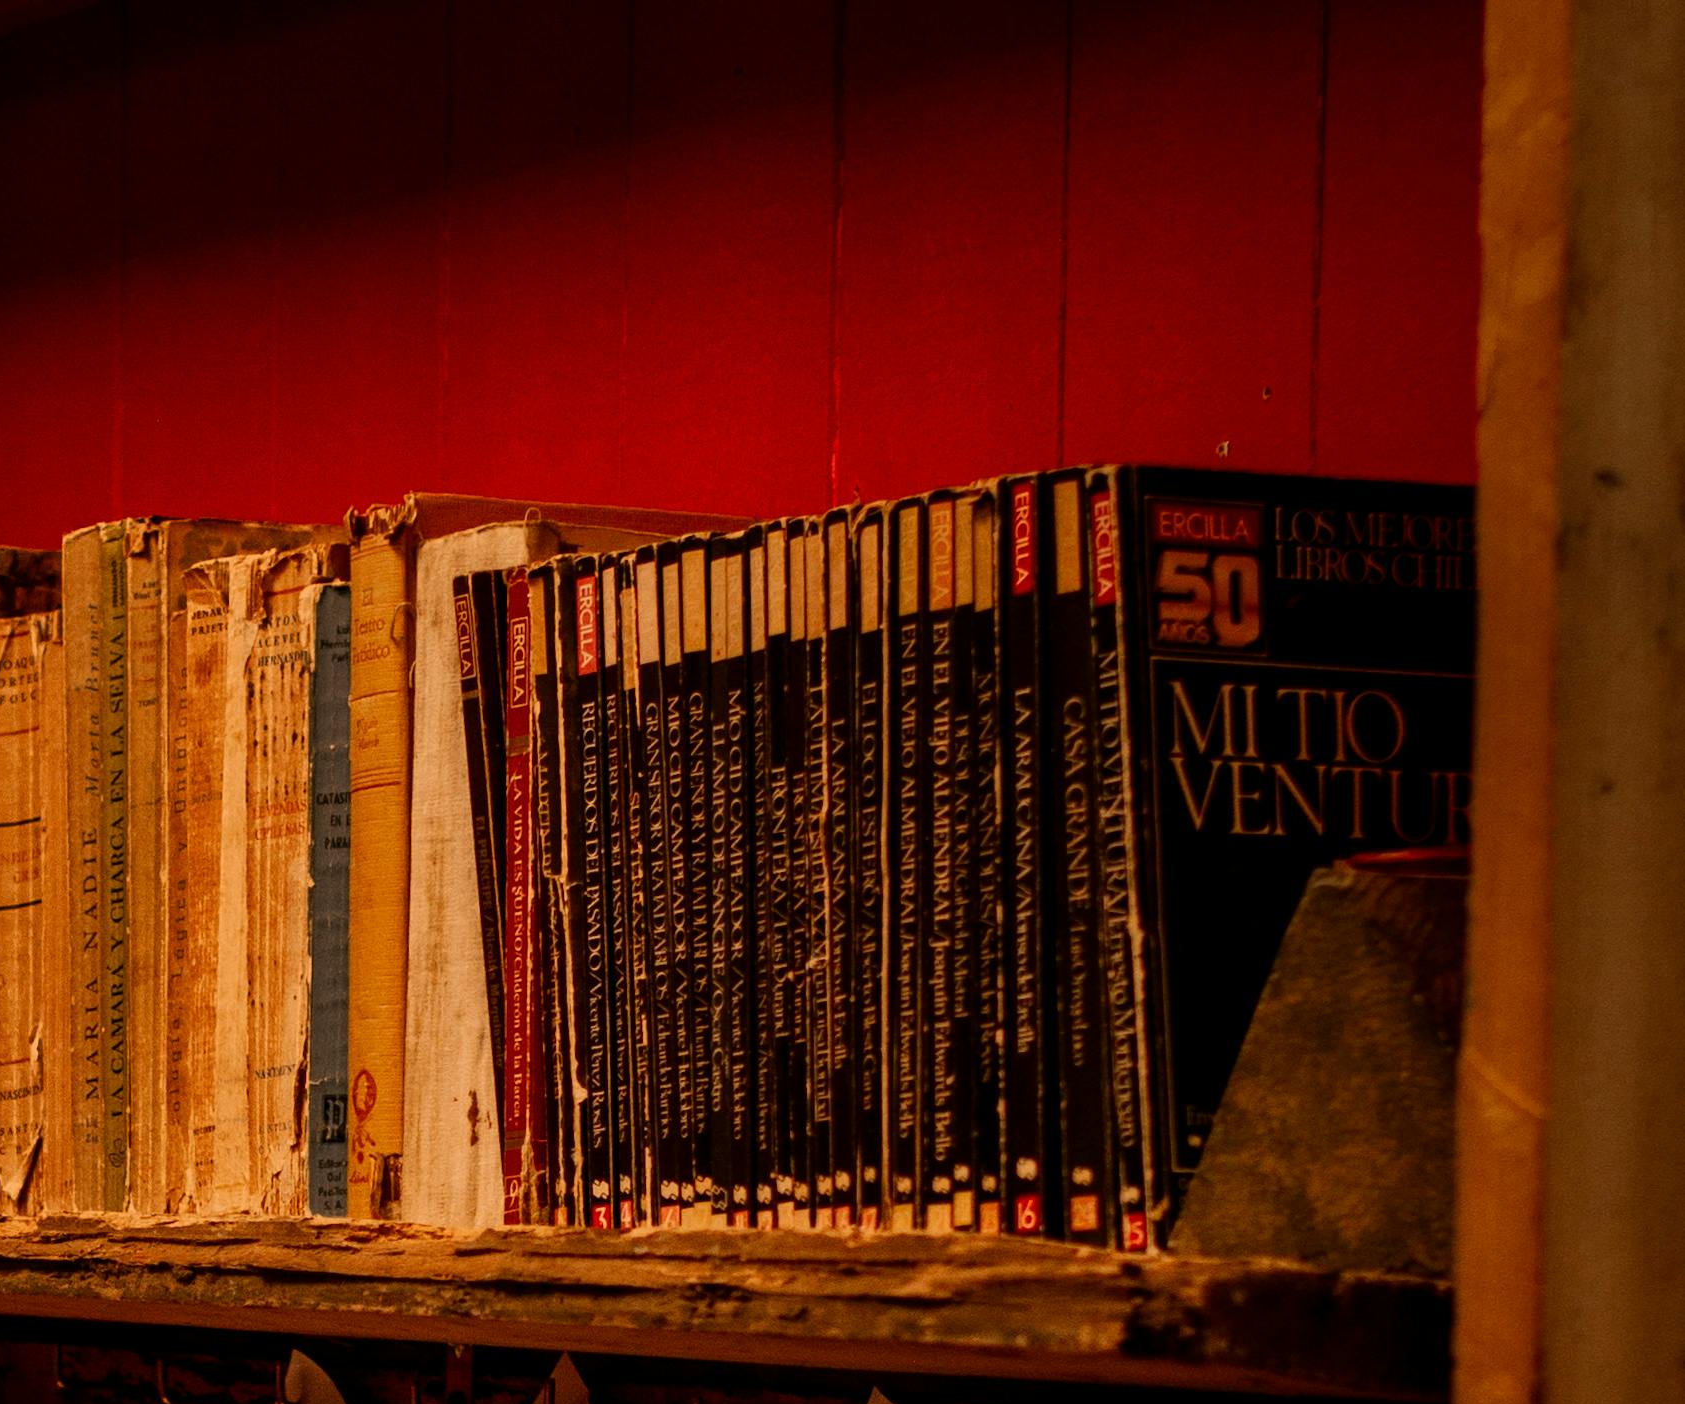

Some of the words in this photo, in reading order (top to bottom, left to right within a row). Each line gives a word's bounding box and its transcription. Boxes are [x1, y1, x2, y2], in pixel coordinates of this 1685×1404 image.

[933, 509, 951, 601] ERCILLA
[1013, 491, 1030, 585] ERCILLA
[1094, 500, 1114, 598] ERCILLA
[1158, 510, 1252, 542] ERCILLA
[1273, 503, 1337, 546] LOS
[1273, 543, 1387, 588] LIBROS
[577, 583, 594, 668] ERCILLA
[1156, 549, 1263, 650] 50
[454, 599, 474, 678] ERCILLA
[511, 621, 527, 703] ERCILLA
[899, 623, 916, 659] EN
[931, 620, 951, 656] EN
[1098, 650, 1118, 689] MI
[108, 631, 125, 715] SELVA
[861, 681, 877, 717] EL
[900, 665, 916, 698] EL
[932, 662, 950, 695] EL
[644, 702, 660, 768] GRAN
[688, 692, 705, 756] GRAN
[830, 719, 845, 757] LA
[898, 699, 917, 769] VIEJO
[927, 696, 951, 766] VIEJO
[1013, 686, 1033, 726] LA
[1063, 696, 1086, 777] CASA
[1098, 691, 1120, 749] TIO
[1167, 678, 1260, 760] MI
[1275, 687, 1407, 765] TIO
[109, 727, 124, 756] LA
[580, 702, 598, 833] RECUERDOS
[605, 693, 620, 826] RECUERDOS
[668, 750, 682, 797] CID
[728, 746, 743, 793] CID
[861, 720, 878, 799] LOCO
[109, 769, 124, 805] EN
[509, 774, 524, 802] LA
[710, 723, 725, 834] LLAMPO
[1013, 732, 1034, 881] ARAUCANA
[512, 805, 524, 852] VIDA
[585, 838, 600, 882] DEL
[609, 831, 621, 870] DEL
[650, 841, 662, 856] Y
[691, 830, 705, 846] Y
[710, 838, 725, 872] DE
[771, 765, 788, 903] FRONTERA
[792, 772, 805, 912] FRONTERA
[831, 761, 847, 904] ARAUCANA
[860, 805, 878, 906] ESTERO
[1065, 783, 1089, 911] GRANDE
[81, 828, 99, 951] NADIE
[107, 816, 124, 924] CHARCA
[512, 859, 524, 882] ES
[670, 802, 689, 962] CAMPEADOR
[729, 798, 745, 960] CAMPEADOR
[108, 936, 123, 953] Y
[711, 877, 726, 976] SANGRE
[774, 963, 789, 1039] Durand
[84, 976, 100, 1101] MARIA
[513, 1033, 524, 1051] de
[513, 1053, 524, 1069] la
[898, 1012, 916, 1092] Edwards
[933, 1021, 952, 1107] Edwards
[107, 1083, 123, 1118] LA
[513, 1072, 524, 1118] Barca
[1112, 1008, 1138, 1148] Montenegro
[591, 1090, 606, 1149] Rosales
[934, 1112, 952, 1161] Bello
[1018, 1199, 1037, 1230] 16
